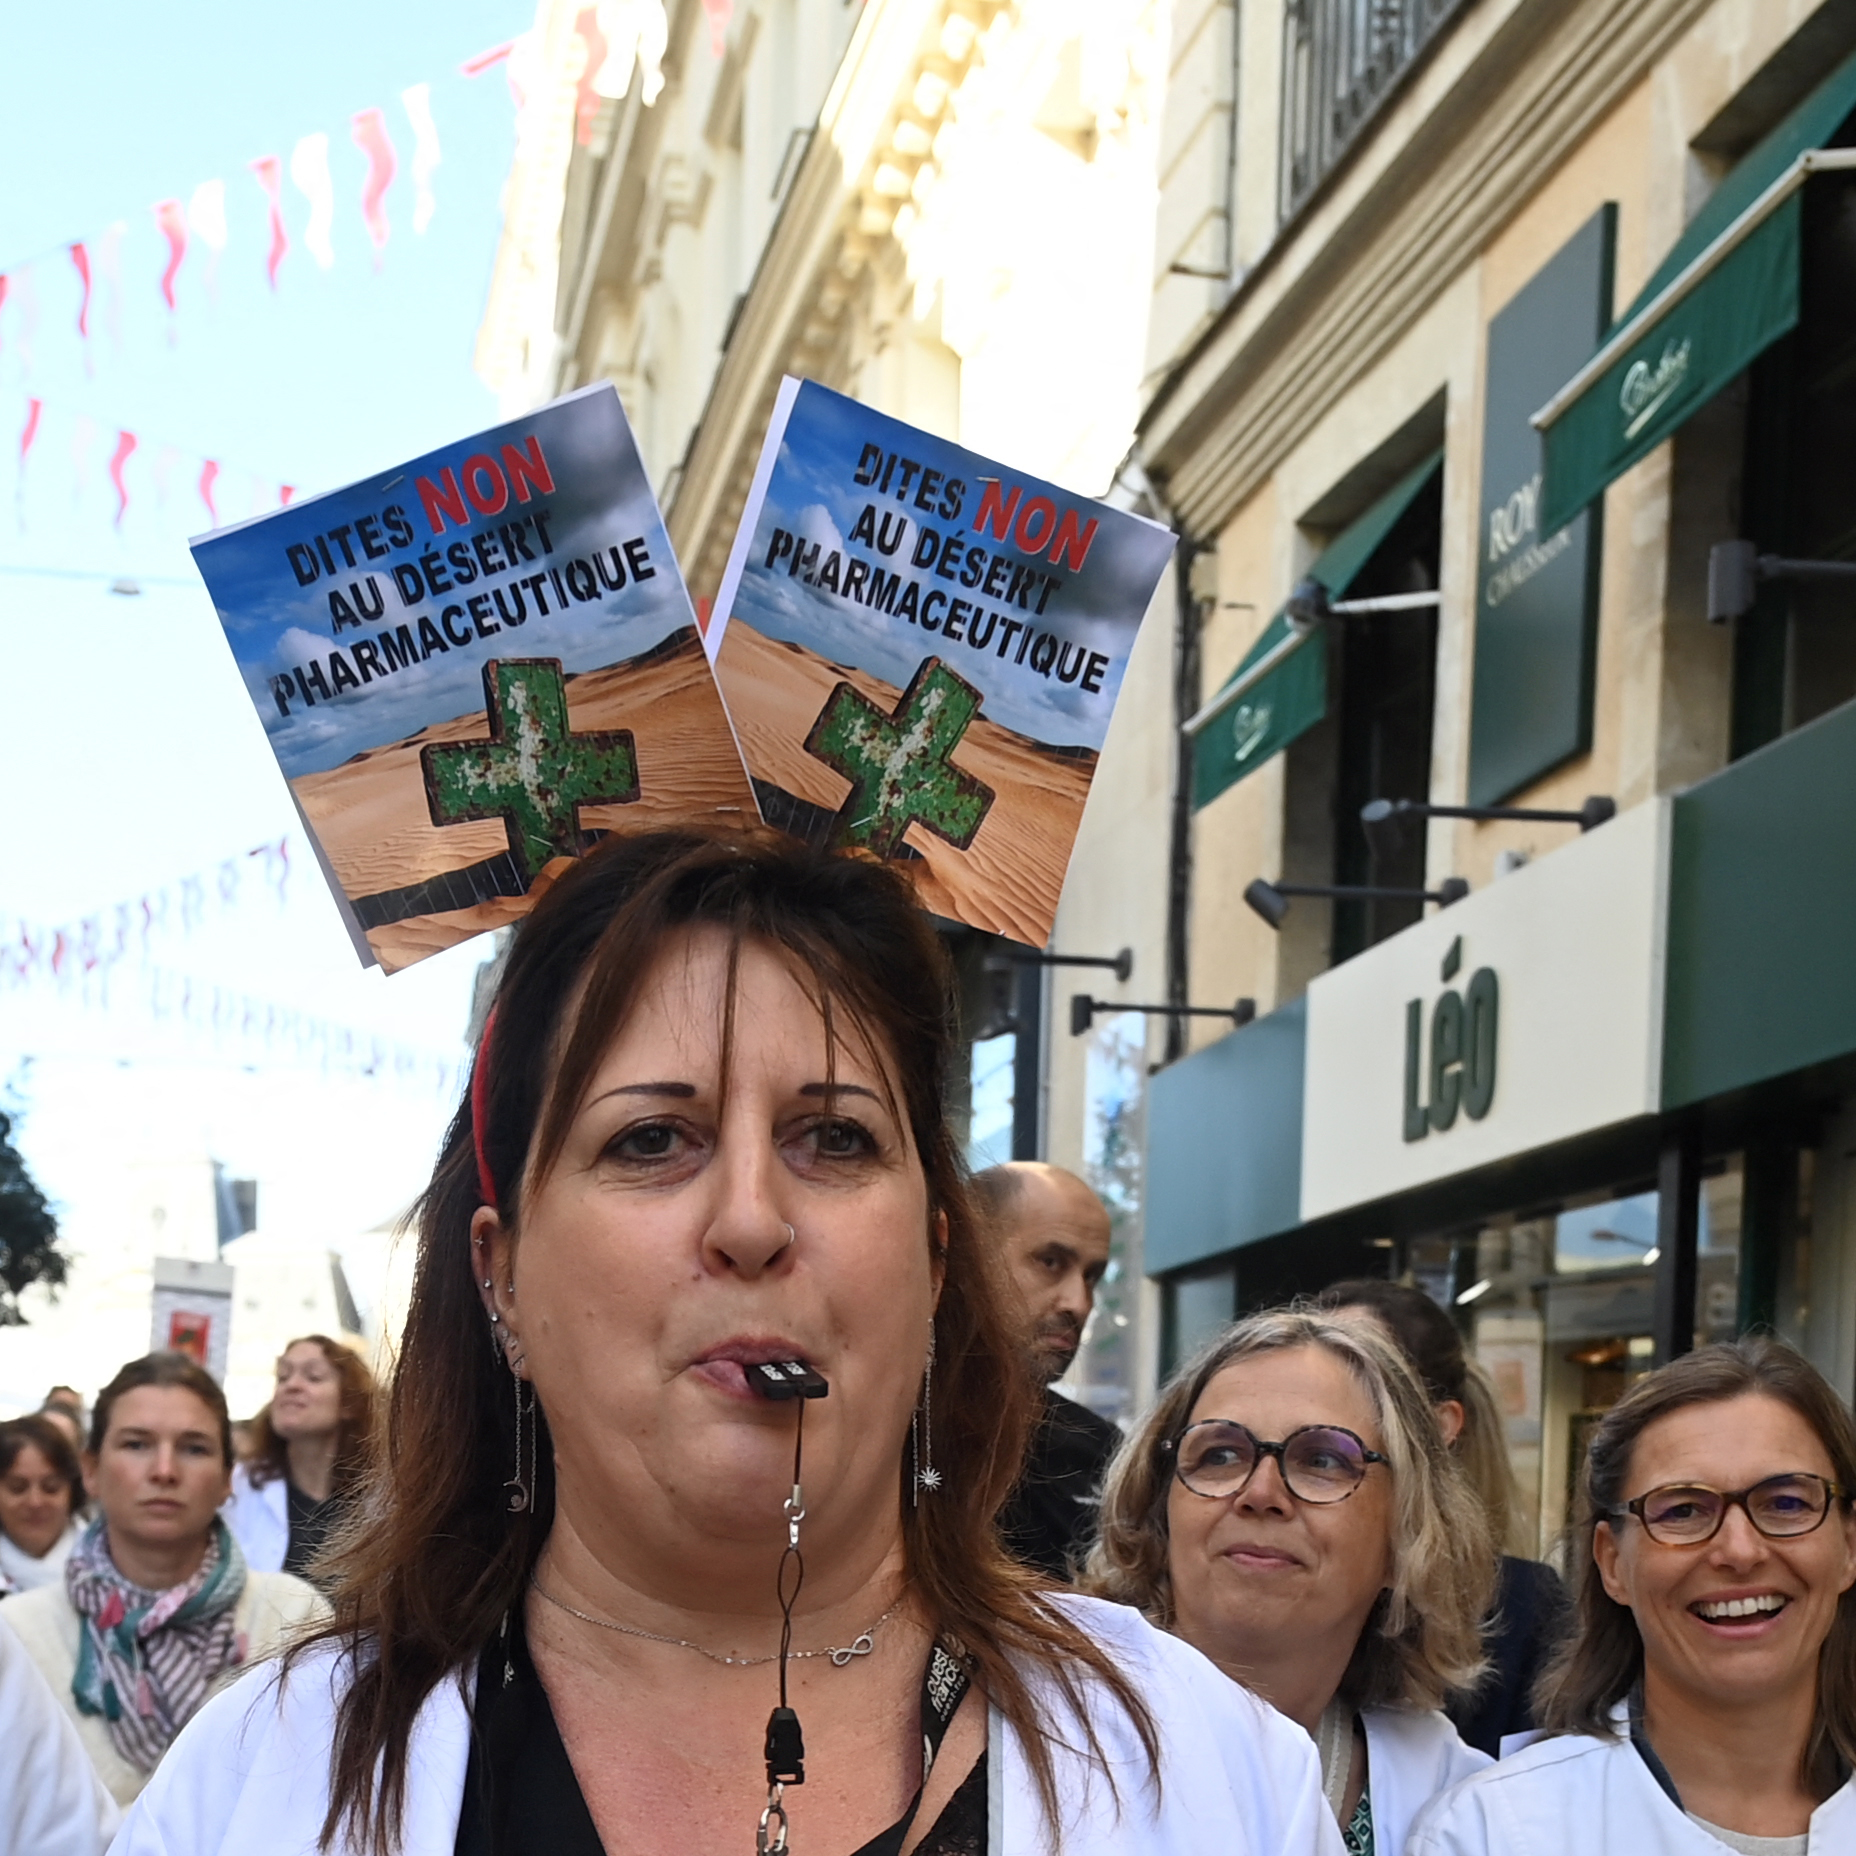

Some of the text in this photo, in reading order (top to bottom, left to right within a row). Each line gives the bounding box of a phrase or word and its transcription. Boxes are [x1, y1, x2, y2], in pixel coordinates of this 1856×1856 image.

[286, 434, 556, 587] DITES NON
[327, 509, 555, 636] AU DÉSERT
[849, 504, 1063, 617] AU DÉSERT
[853, 442, 1100, 574] DITES NON
[267, 537, 657, 718] PHARMACEUTIQUE
[764, 527, 1110, 694] PHARMACEUTIQUE
